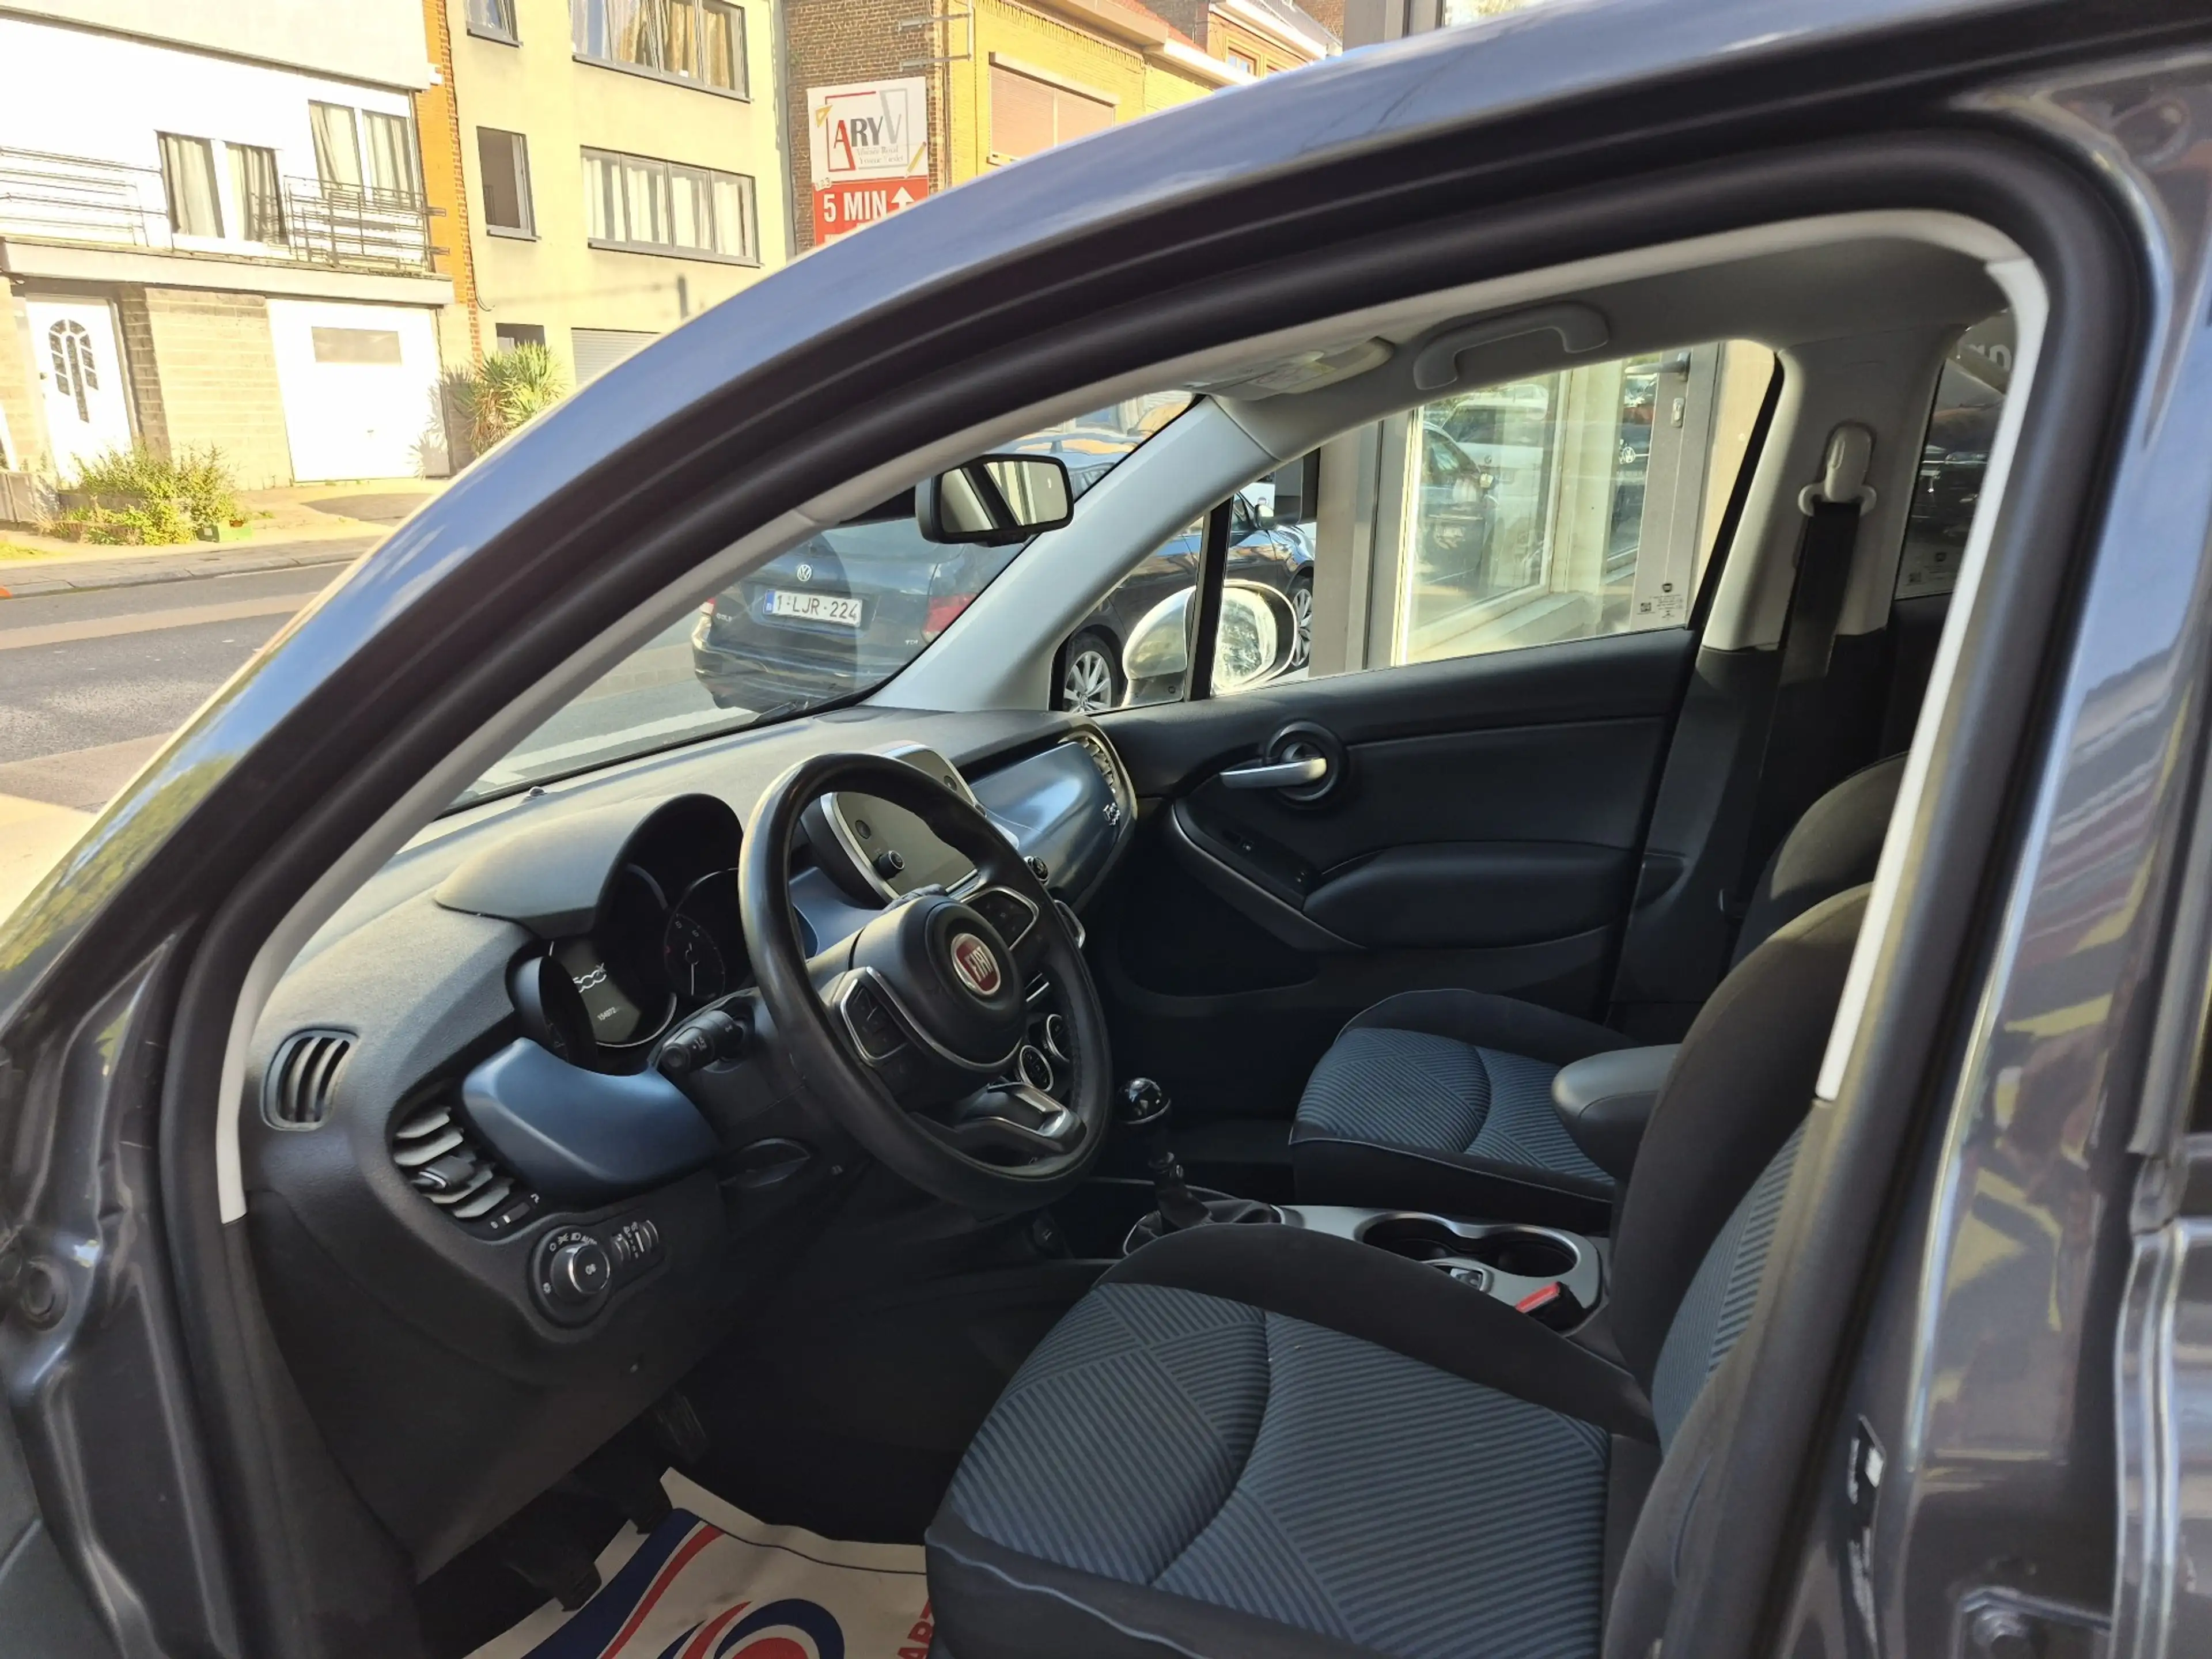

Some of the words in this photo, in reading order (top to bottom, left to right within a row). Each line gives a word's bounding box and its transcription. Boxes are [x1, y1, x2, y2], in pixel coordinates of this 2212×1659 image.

[823, 194, 836, 222] 5
[843, 190, 887, 221] MIN
[964, 946, 994, 982] FIAT
